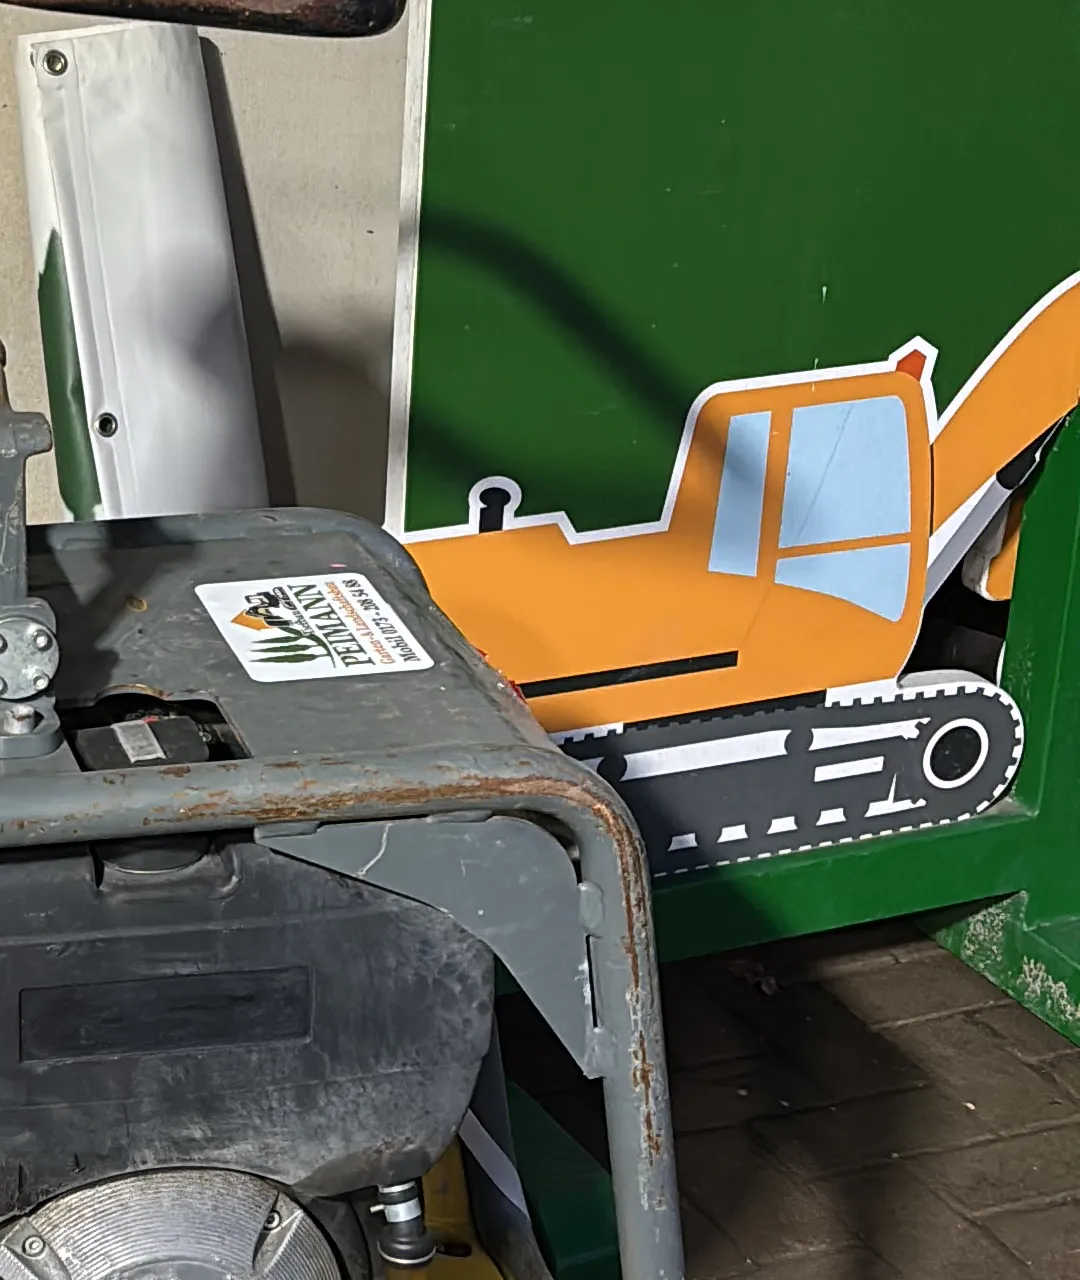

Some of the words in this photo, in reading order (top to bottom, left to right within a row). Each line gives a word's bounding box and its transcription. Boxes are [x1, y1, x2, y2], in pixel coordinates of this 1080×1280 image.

[358, 599, 380, 611] 208
[287, 584, 376, 667] PEIMANN
[372, 617, 398, 635] 0173
[384, 635, 421, 662] Mobil
